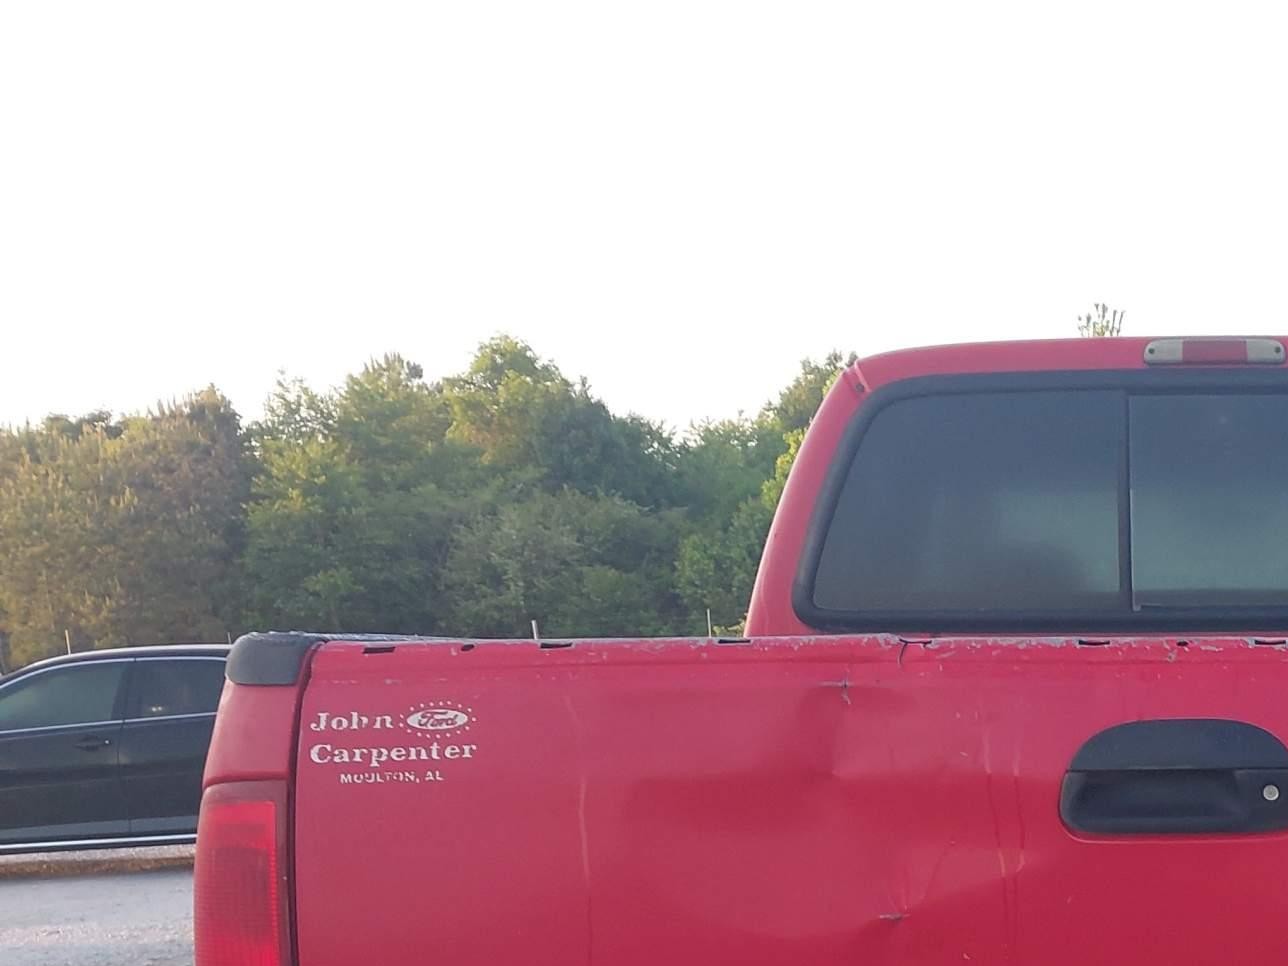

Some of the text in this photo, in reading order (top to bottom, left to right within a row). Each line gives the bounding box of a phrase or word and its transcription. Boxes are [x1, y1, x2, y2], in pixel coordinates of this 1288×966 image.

[310, 711, 394, 731] John
[310, 742, 477, 767] Carpenter
[425, 770, 445, 782] AL
